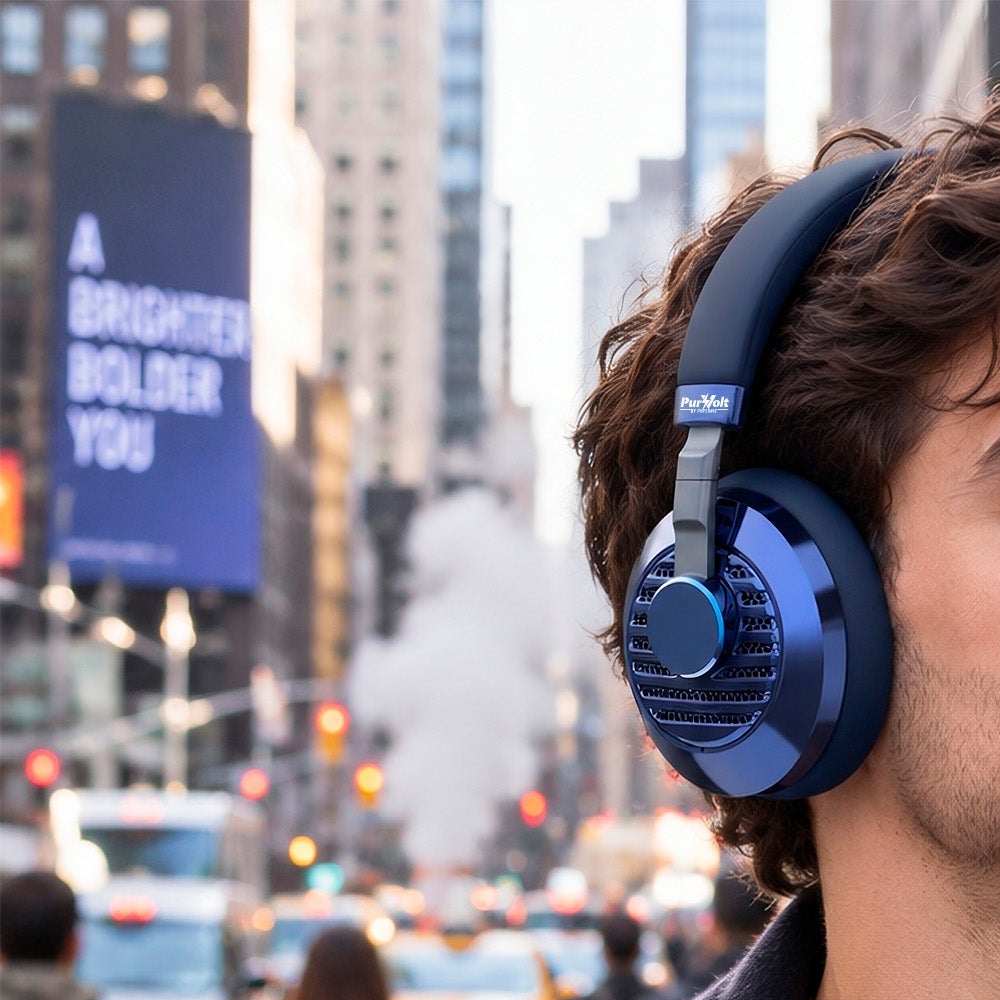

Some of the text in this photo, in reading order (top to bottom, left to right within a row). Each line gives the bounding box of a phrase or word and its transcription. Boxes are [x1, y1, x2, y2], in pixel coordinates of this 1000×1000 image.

[68, 213, 105, 274] A
[67, 341, 223, 418] BOLDER
[66, 404, 156, 473] YOU
